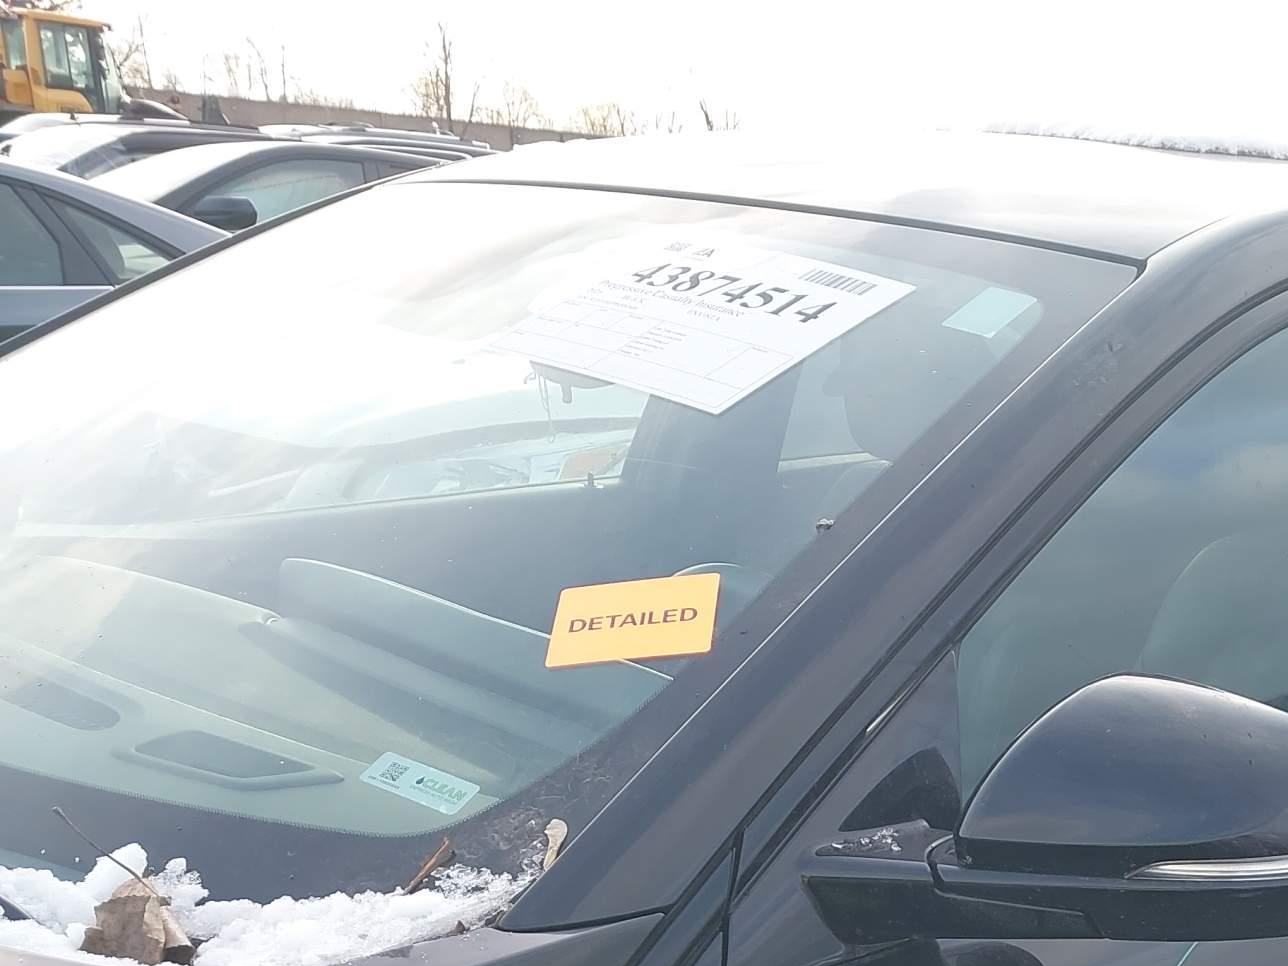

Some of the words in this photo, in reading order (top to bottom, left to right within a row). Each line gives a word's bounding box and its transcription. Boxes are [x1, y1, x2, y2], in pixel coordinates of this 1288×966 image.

[631, 262, 838, 324] 43874514
[568, 607, 699, 633] DETAILED
[422, 778, 468, 801] CLEAN
